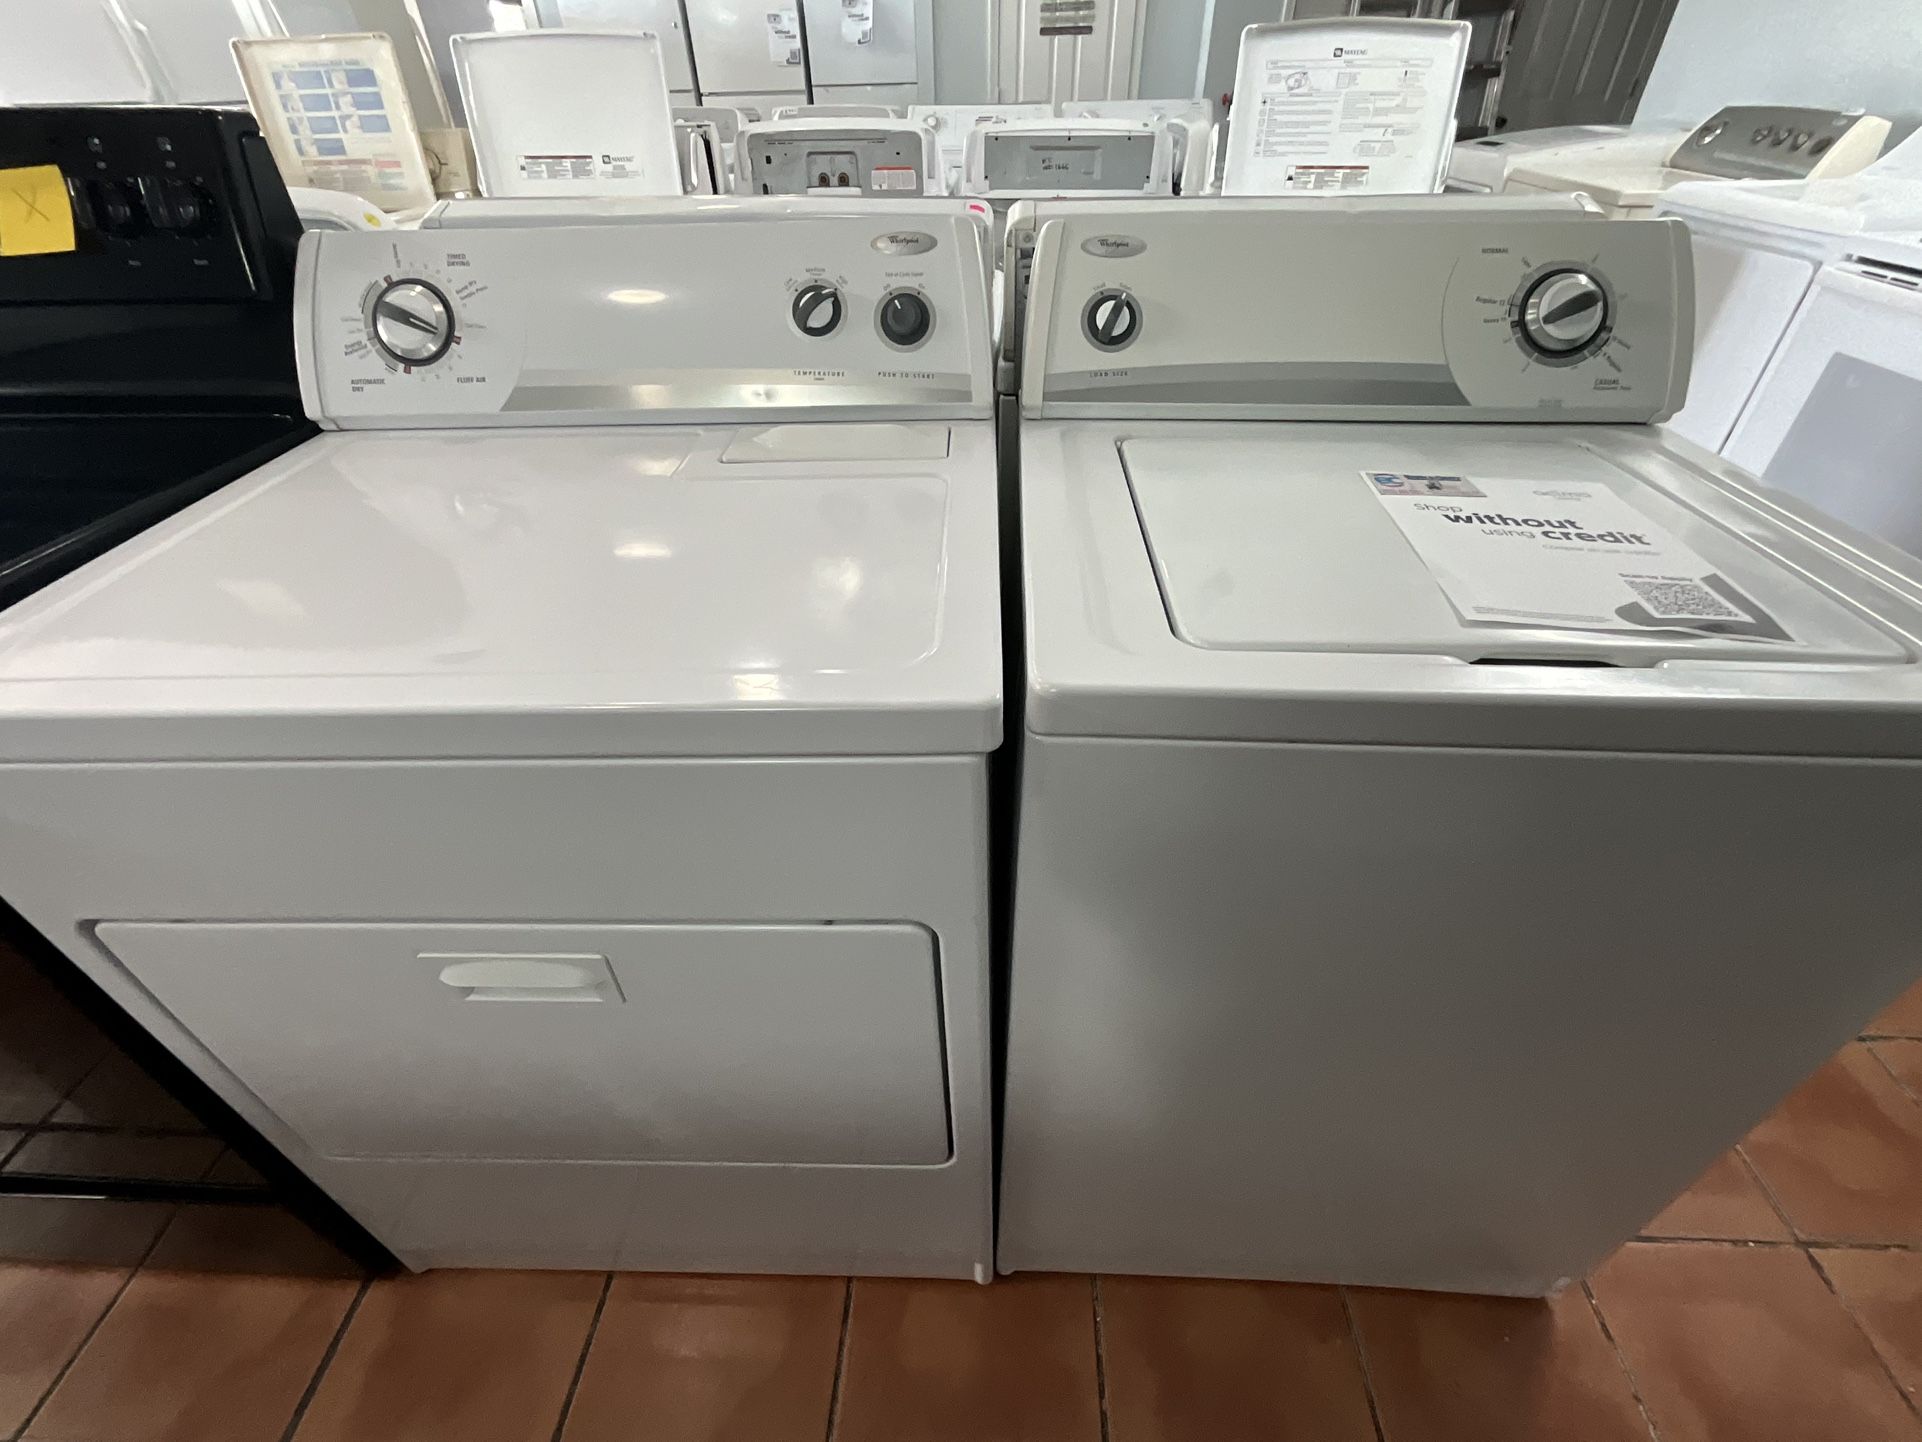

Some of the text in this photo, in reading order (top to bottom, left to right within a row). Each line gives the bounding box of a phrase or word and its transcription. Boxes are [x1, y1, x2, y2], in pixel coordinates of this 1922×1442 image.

[887, 235, 920, 246] Whirlpool
[1097, 238, 1129, 249] Whirlpool
[793, 370, 846, 378] TEMPERATURE
[1442, 512, 1584, 531] without
[1482, 528, 1653, 546] using credit
